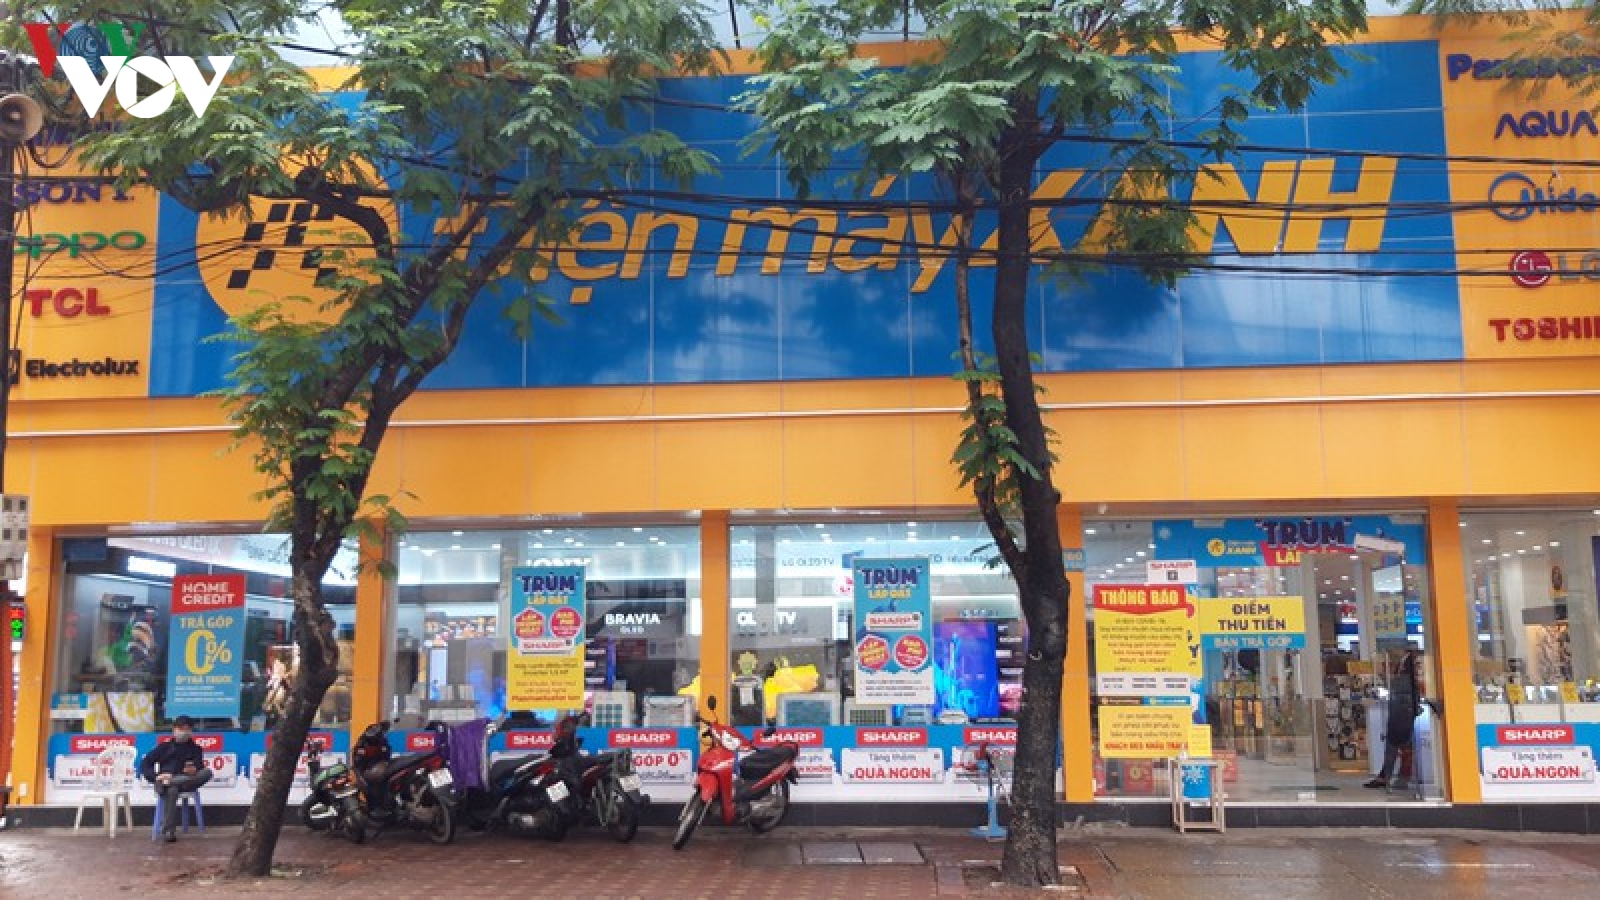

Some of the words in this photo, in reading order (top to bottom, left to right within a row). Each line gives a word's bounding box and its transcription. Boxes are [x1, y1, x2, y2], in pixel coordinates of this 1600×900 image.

[1494, 110, 1599, 140] AQUA
[715, 174, 967, 293] máy
[25, 287, 111, 318] TCL
[26, 357, 139, 378] Electrolux
[1275, 548, 1300, 564] LẮ
[182, 582, 229, 593] HOME
[182, 593, 235, 605] CREDIT
[1100, 588, 1146, 605] THÔNG
[1150, 588, 1179, 605] BÁO
[1232, 598, 1270, 615] ĐIỂM
[207, 615, 234, 629] GÓP
[605, 613, 661, 625] BRAVIA
[1218, 619, 1249, 631] THU
[1252, 615, 1287, 631] TIỀN
[186, 629, 232, 675] 0%
[513, 735, 554, 745] SHA
[615, 733, 671, 743] SHARP
[864, 733, 921, 742] SHARP
[970, 733, 1017, 742] SHAR
[1504, 729, 1566, 740] SHARP
[854, 764, 885, 779] QUÀ
[886, 767, 931, 779] NGON
[1498, 763, 1531, 779] QUÀ
[1535, 766, 1580, 779] NGON
